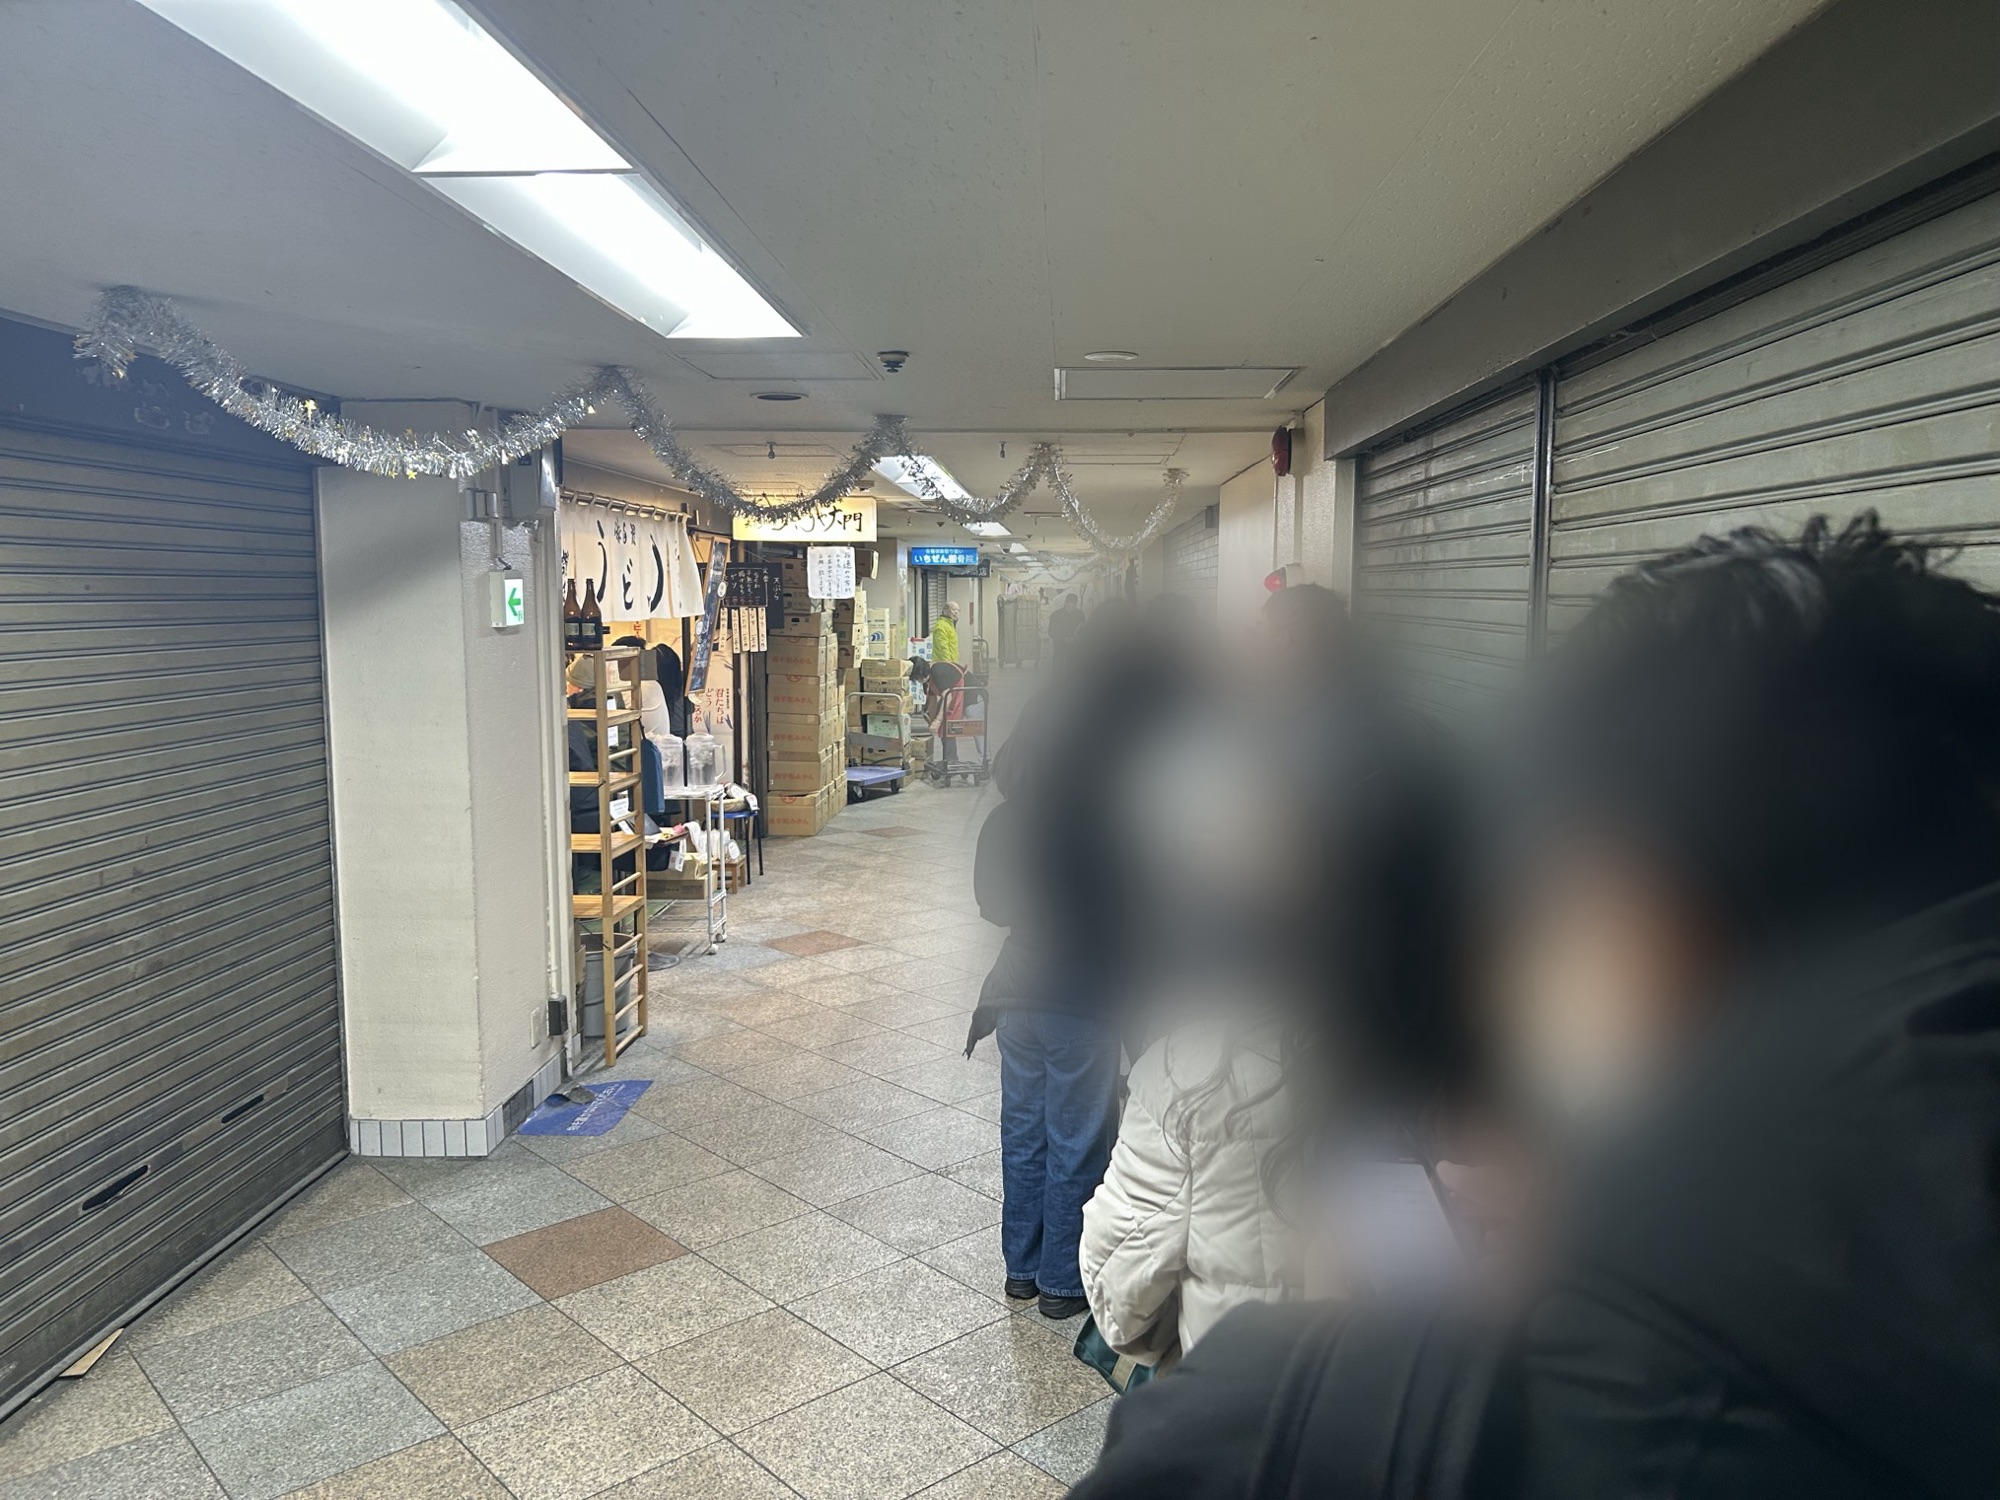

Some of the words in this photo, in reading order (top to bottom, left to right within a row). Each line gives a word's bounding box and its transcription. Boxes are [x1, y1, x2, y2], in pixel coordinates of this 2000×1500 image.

[773, 577, 781, 601] 天ぷら
[715, 688, 724, 724] 君たちは
